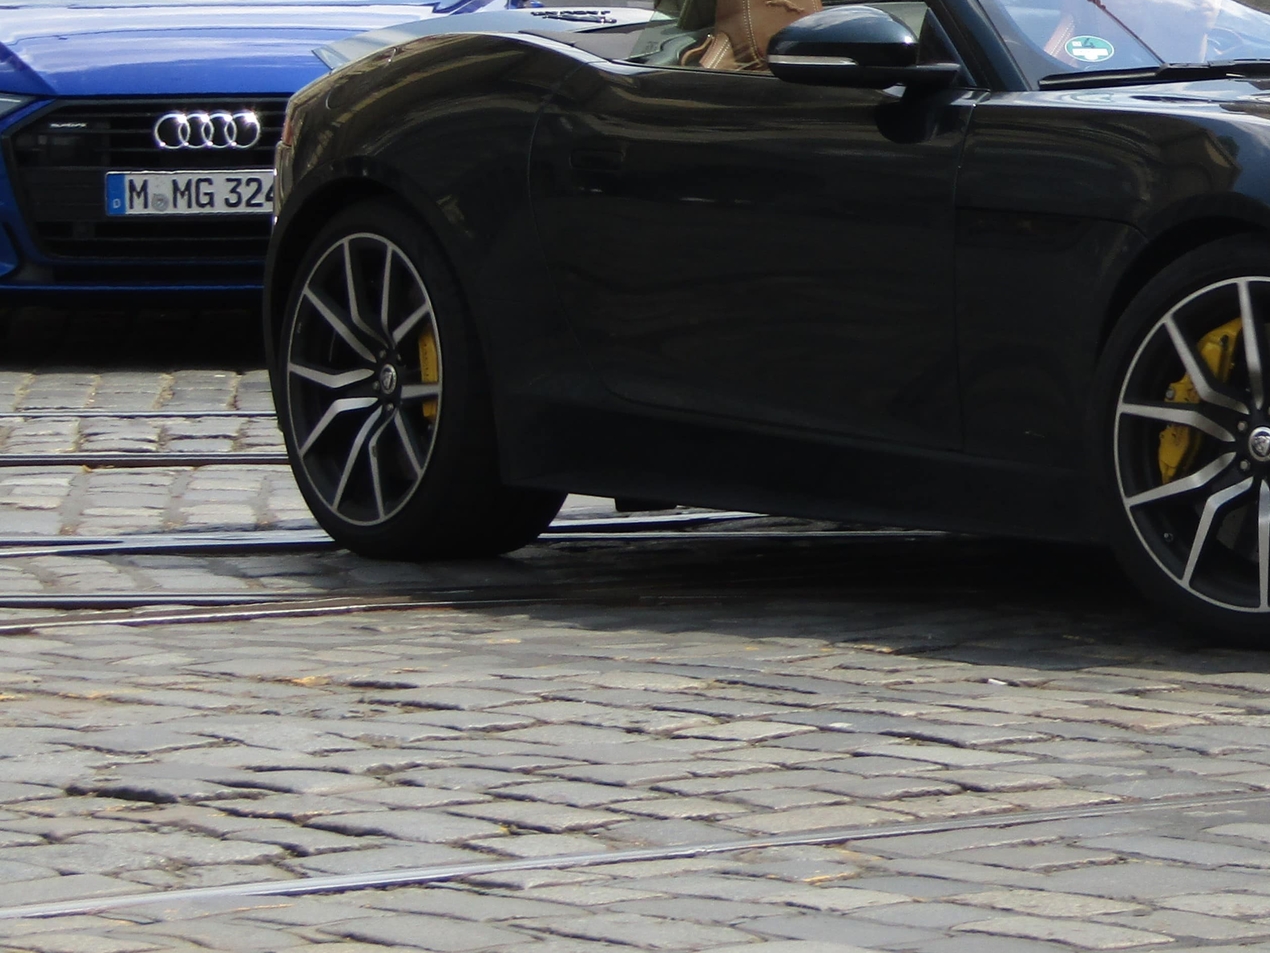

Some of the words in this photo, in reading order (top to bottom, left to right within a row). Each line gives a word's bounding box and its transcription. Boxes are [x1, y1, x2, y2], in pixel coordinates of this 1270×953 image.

[112, 199, 121, 209] D
[128, 178, 149, 210] M
[172, 177, 215, 209] MG
